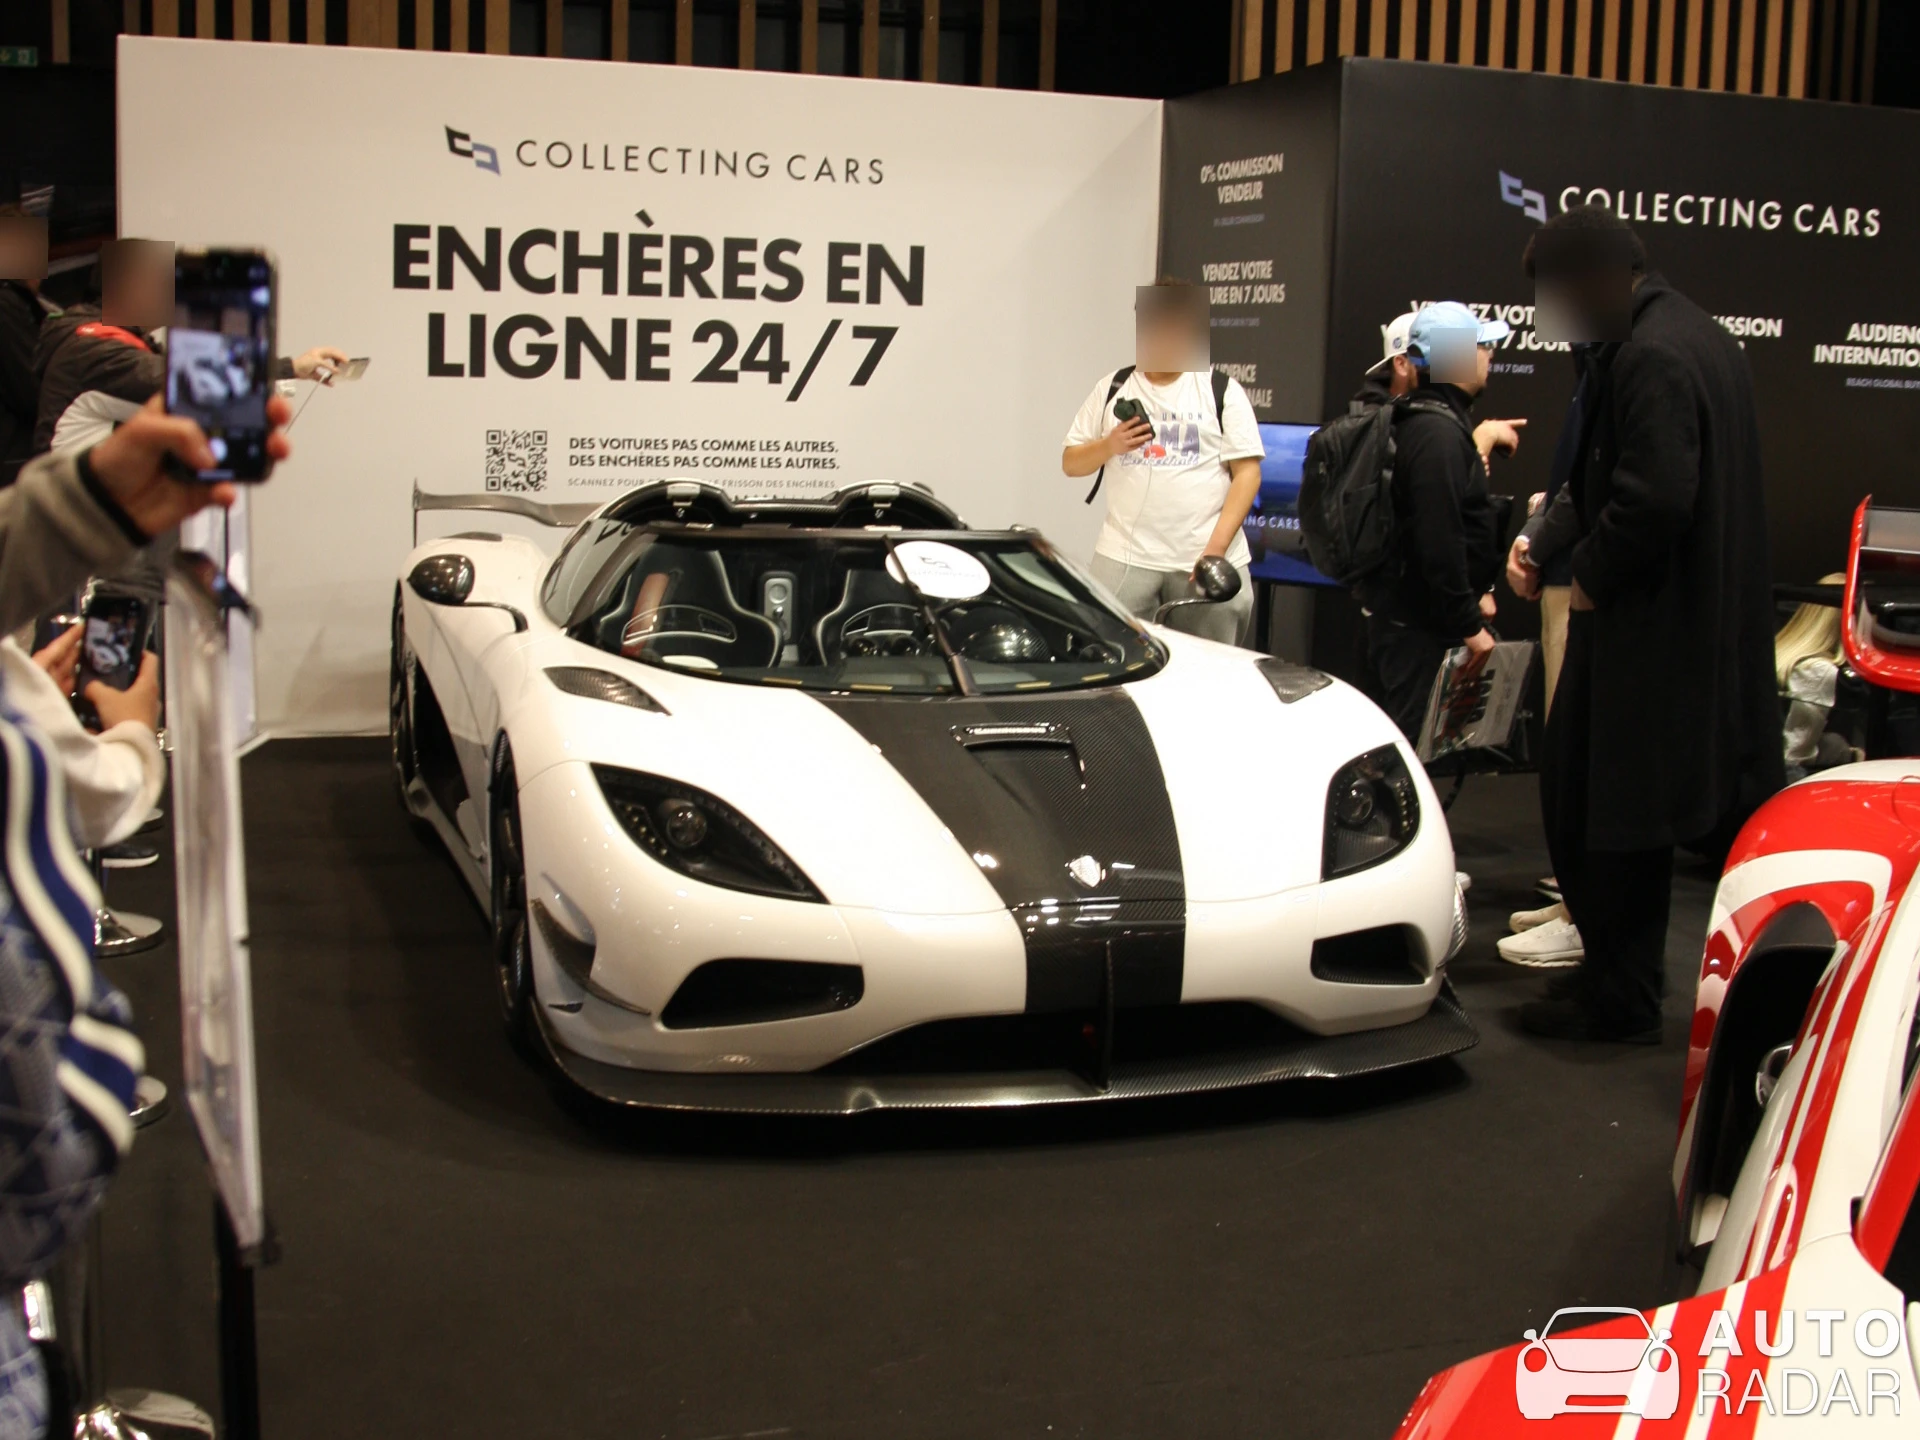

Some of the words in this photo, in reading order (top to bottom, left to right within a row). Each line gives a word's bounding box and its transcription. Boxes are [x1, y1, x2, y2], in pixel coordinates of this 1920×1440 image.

[516, 139, 770, 178] COLLECTING
[786, 154, 885, 185] CARS
[1201, 165, 1216, 184] 0%
[1217, 152, 1284, 182] COMMISSION
[1217, 181, 1264, 205] VENDEUR
[1793, 203, 1881, 237] CARS
[393, 209, 805, 303] ENCHÈRES
[826, 241, 925, 306] EN
[1202, 262, 1240, 282] VENDEZ
[1241, 260, 1273, 280] VOTRE
[1229, 286, 1243, 304] EN
[1244, 285, 1252, 304] 7
[1251, 284, 1286, 304] JOURS
[427, 312, 672, 382] LIGNE
[691, 318, 899, 402] 24/7
[1162, 412, 1203, 421] UNION
[569, 437, 596, 450] DES
[599, 437, 669, 450] VOITURES
[672, 438, 698, 451] PAS
[701, 439, 756, 452] COMME
[758, 440, 781, 452] LES
[783, 440, 839, 453] AUTRES.
[569, 454, 596, 467] DES
[599, 450, 670, 467] ENCHÈRES
[673, 455, 700, 468] PAS
[702, 455, 758, 468] COMME
[760, 456, 783, 469] LES
[785, 457, 840, 469] AUTRES.
[567, 477, 615, 487] SCANNEZ
[721, 480, 763, 488] FRISSON
[765, 480, 784, 489] DES
[1268, 516, 1301, 530] CARS
